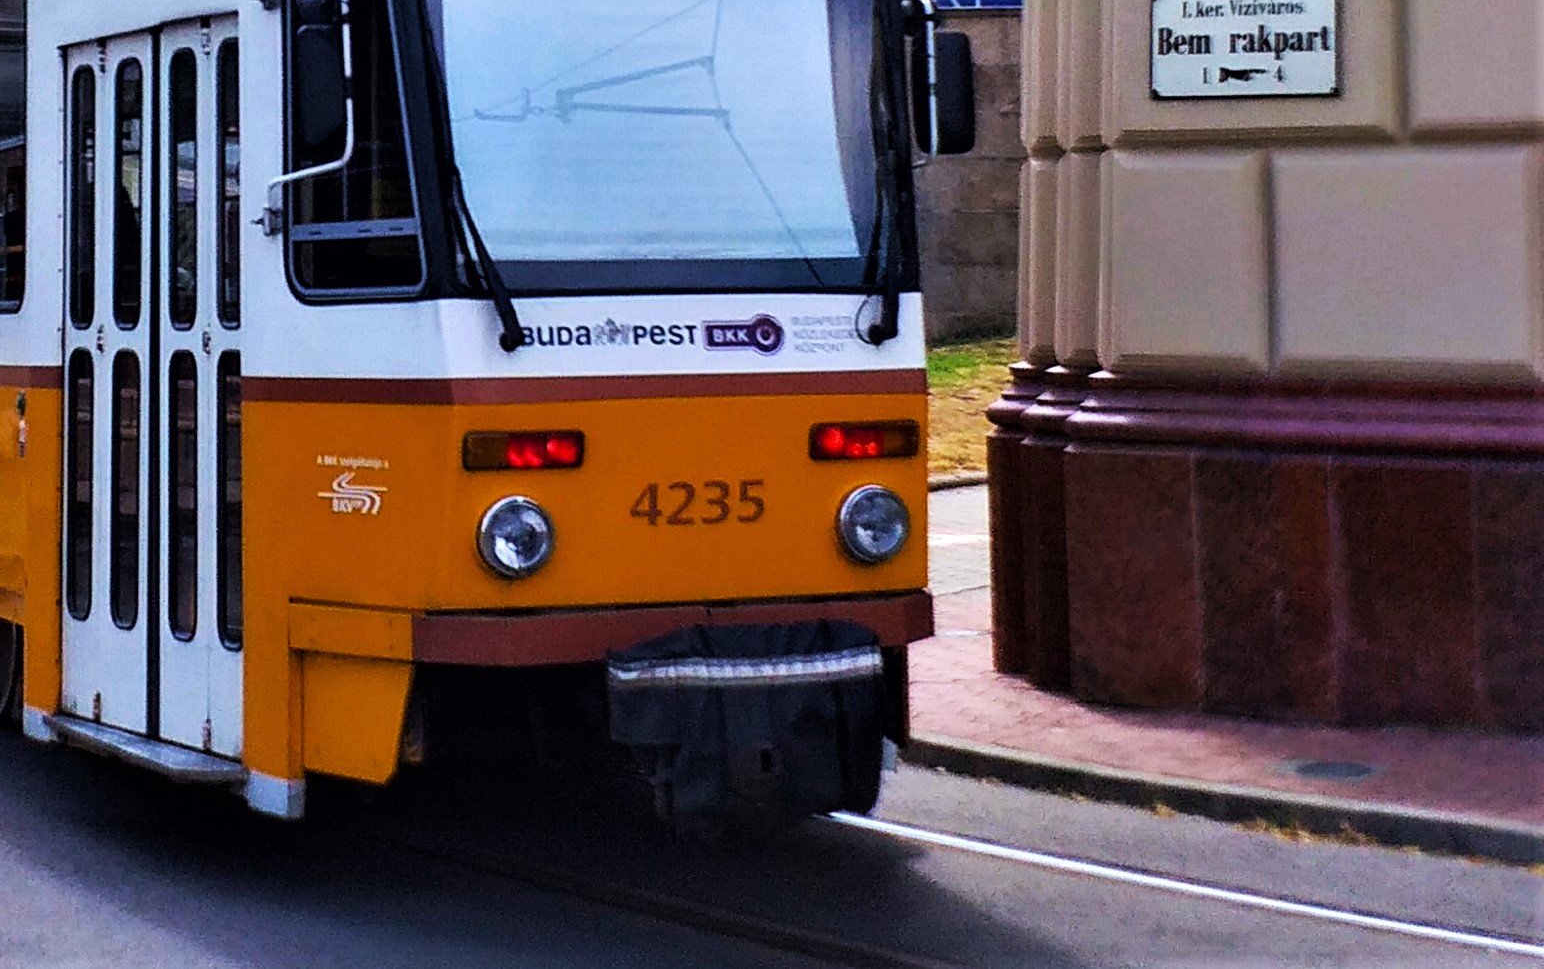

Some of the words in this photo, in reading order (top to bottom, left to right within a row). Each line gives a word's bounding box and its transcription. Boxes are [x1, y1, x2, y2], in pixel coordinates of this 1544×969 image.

[1196, 0, 1224, 18] ker.
[1158, 27, 1211, 55] Bem
[1228, 24, 1330, 60] rakpart
[712, 328, 749, 343] BKK
[629, 479, 765, 526] 4235
